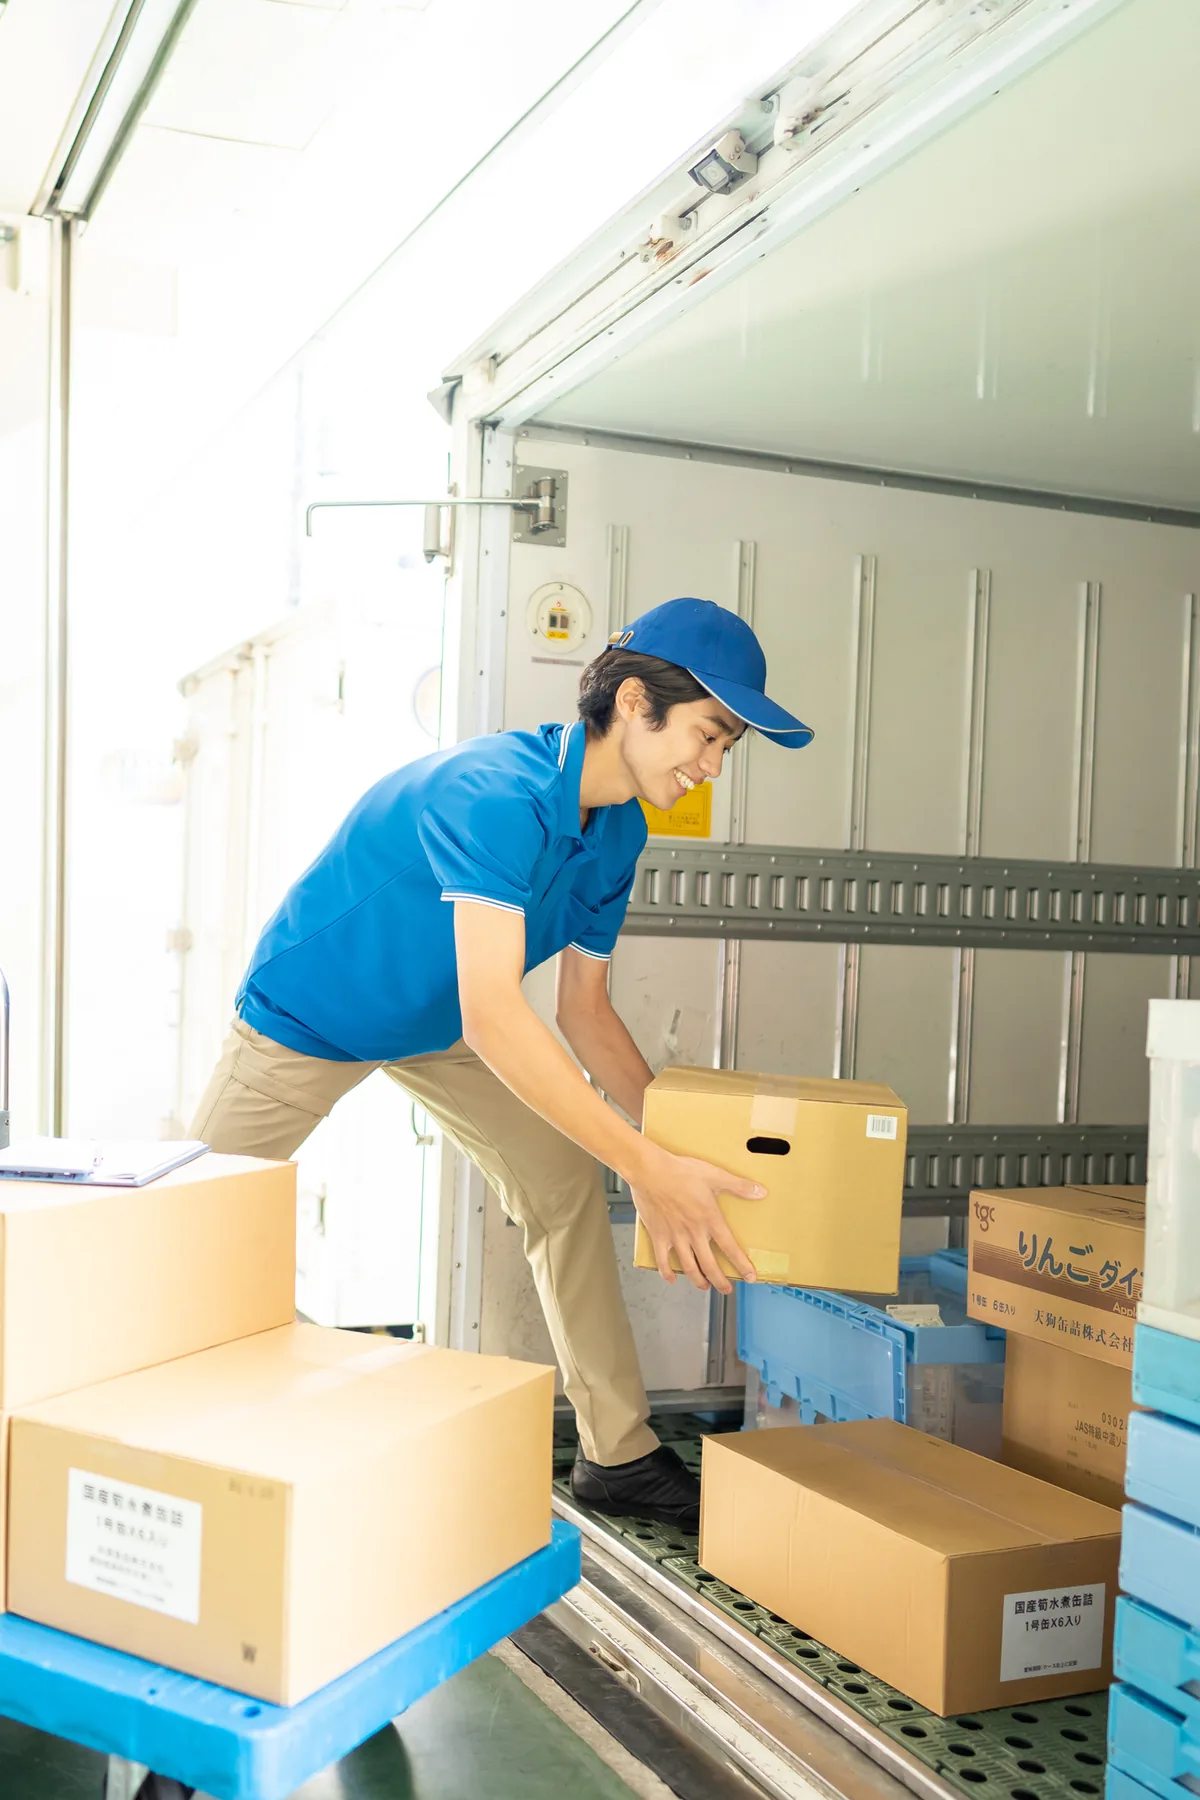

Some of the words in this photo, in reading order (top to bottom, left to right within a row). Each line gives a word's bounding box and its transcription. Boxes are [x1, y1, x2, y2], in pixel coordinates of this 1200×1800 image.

[1018, 1231, 1143, 1297] りんごダイ
[1113, 1302, 1136, 1318] Appl
[1014, 1593, 1093, 1614] 国産筍水煮缶詰
